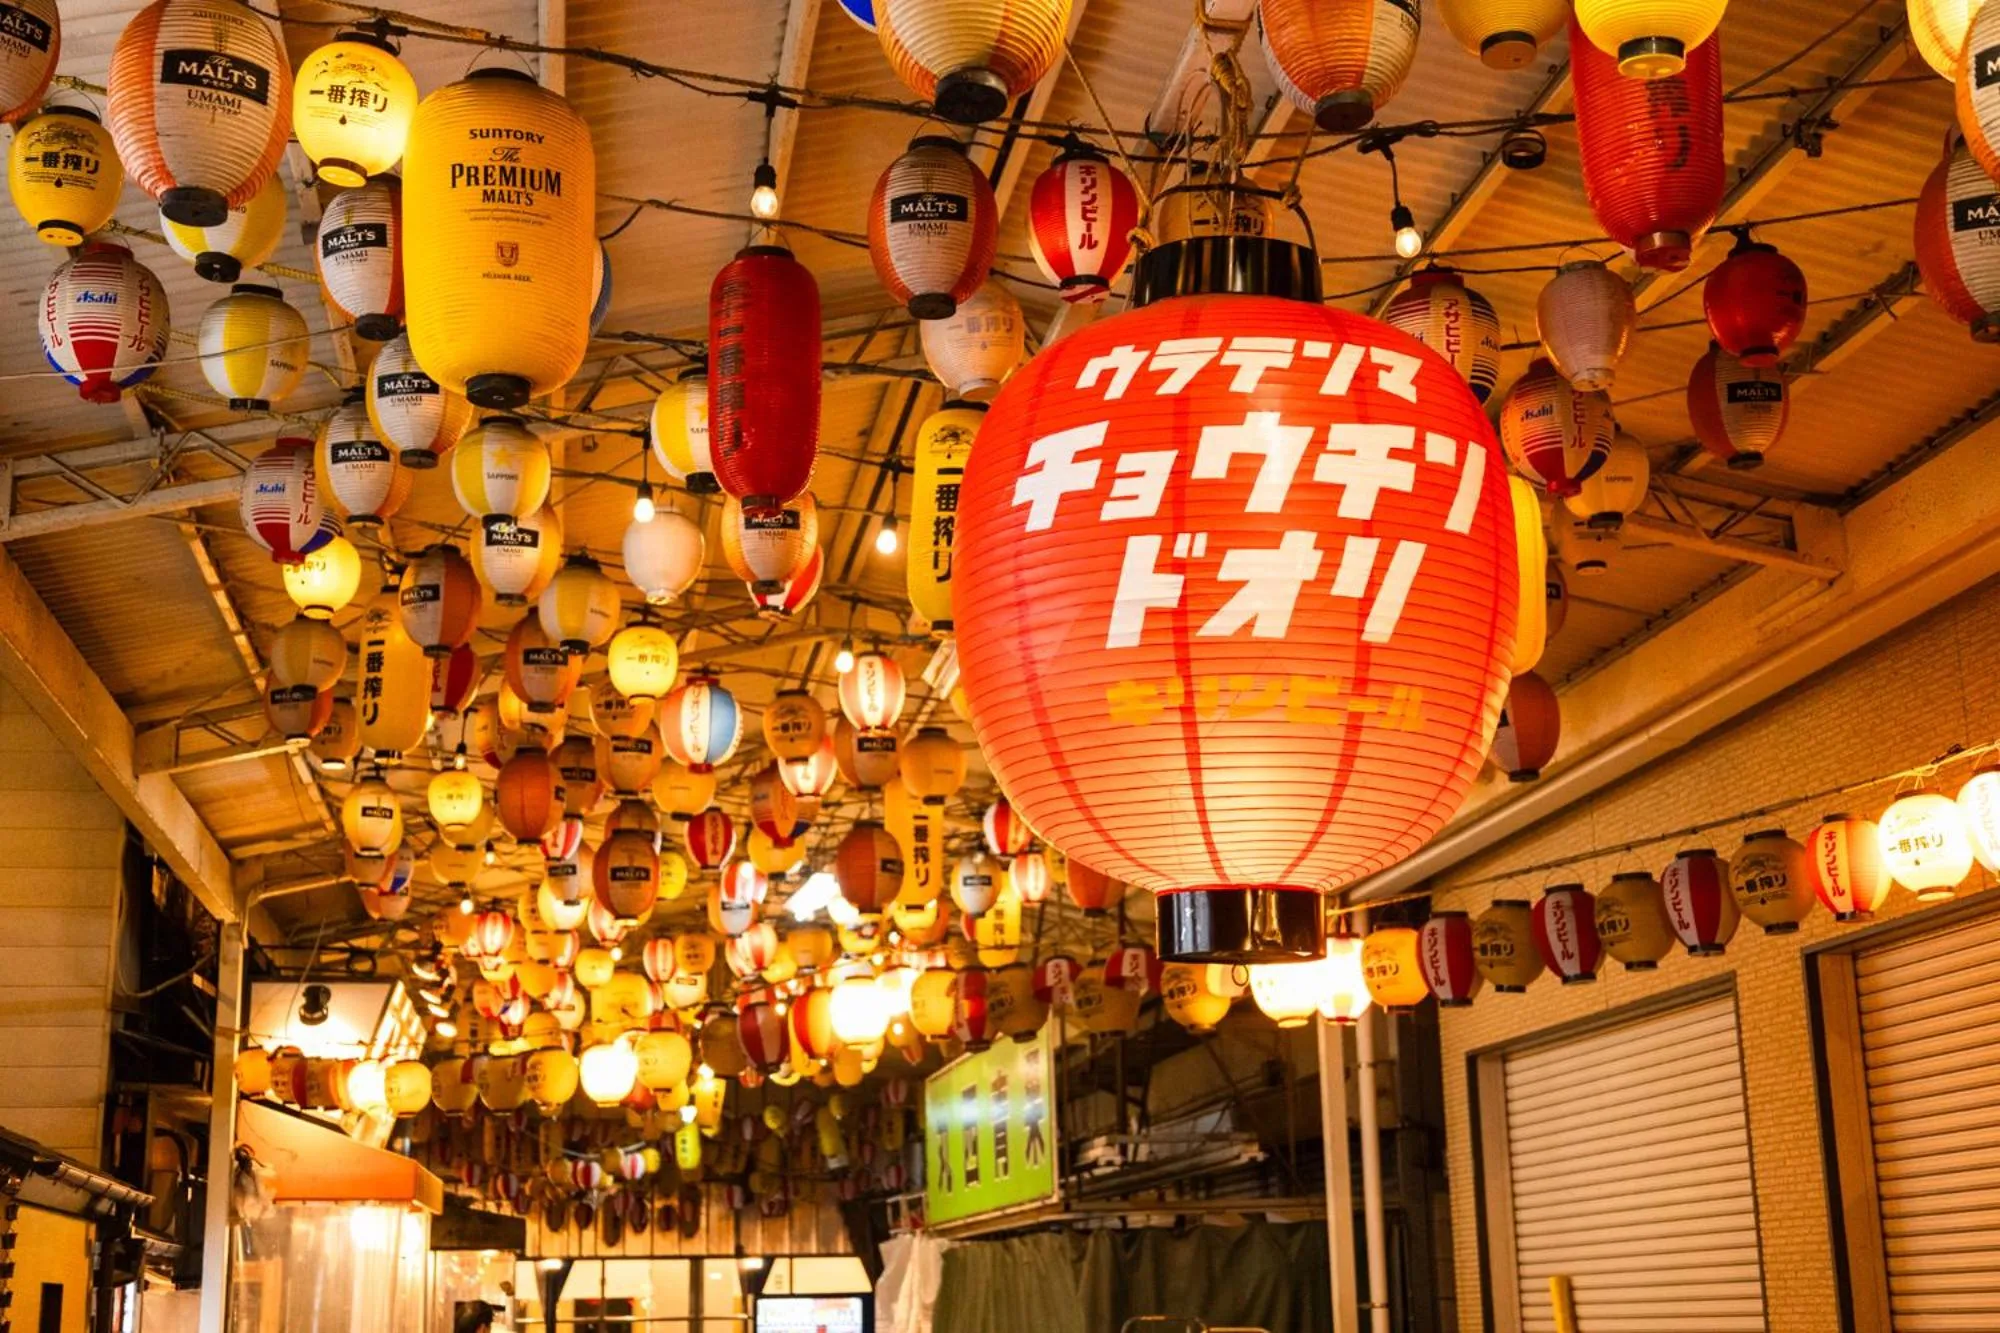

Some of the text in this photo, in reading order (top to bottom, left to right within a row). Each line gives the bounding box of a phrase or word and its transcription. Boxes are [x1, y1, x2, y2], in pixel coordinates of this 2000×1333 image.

[0, 12, 43, 40] ALT'S
[178, 61, 257, 89] MALT'S
[187, 89, 242, 109] UMAMI
[309, 84, 388, 113] 一番搾り
[469, 128, 545, 144] SUNTORY
[25, 151, 99, 175] 一番搾り
[489, 147, 522, 162] The
[451, 163, 561, 197] PREMIUM
[482, 189, 534, 207] MALT'S
[901, 201, 958, 214] MALT'S
[328, 229, 376, 248] MALT'S
[76, 291, 118, 304] Asahi
[1443, 298, 1461, 366] アサヒビー
[1075, 337, 1423, 403] ウラテンマ
[384, 379, 431, 393] MALT'S
[338, 447, 382, 459] MALT'S
[1012, 411, 1487, 533] チョウチン
[491, 531, 532, 543] MALT'S
[1105, 530, 1427, 650] ドオリ
[362, 639, 386, 726] 一番搾り
[1888, 834, 1943, 854] 一番搾り
[1736, 873, 1787, 893] 一番搾り
